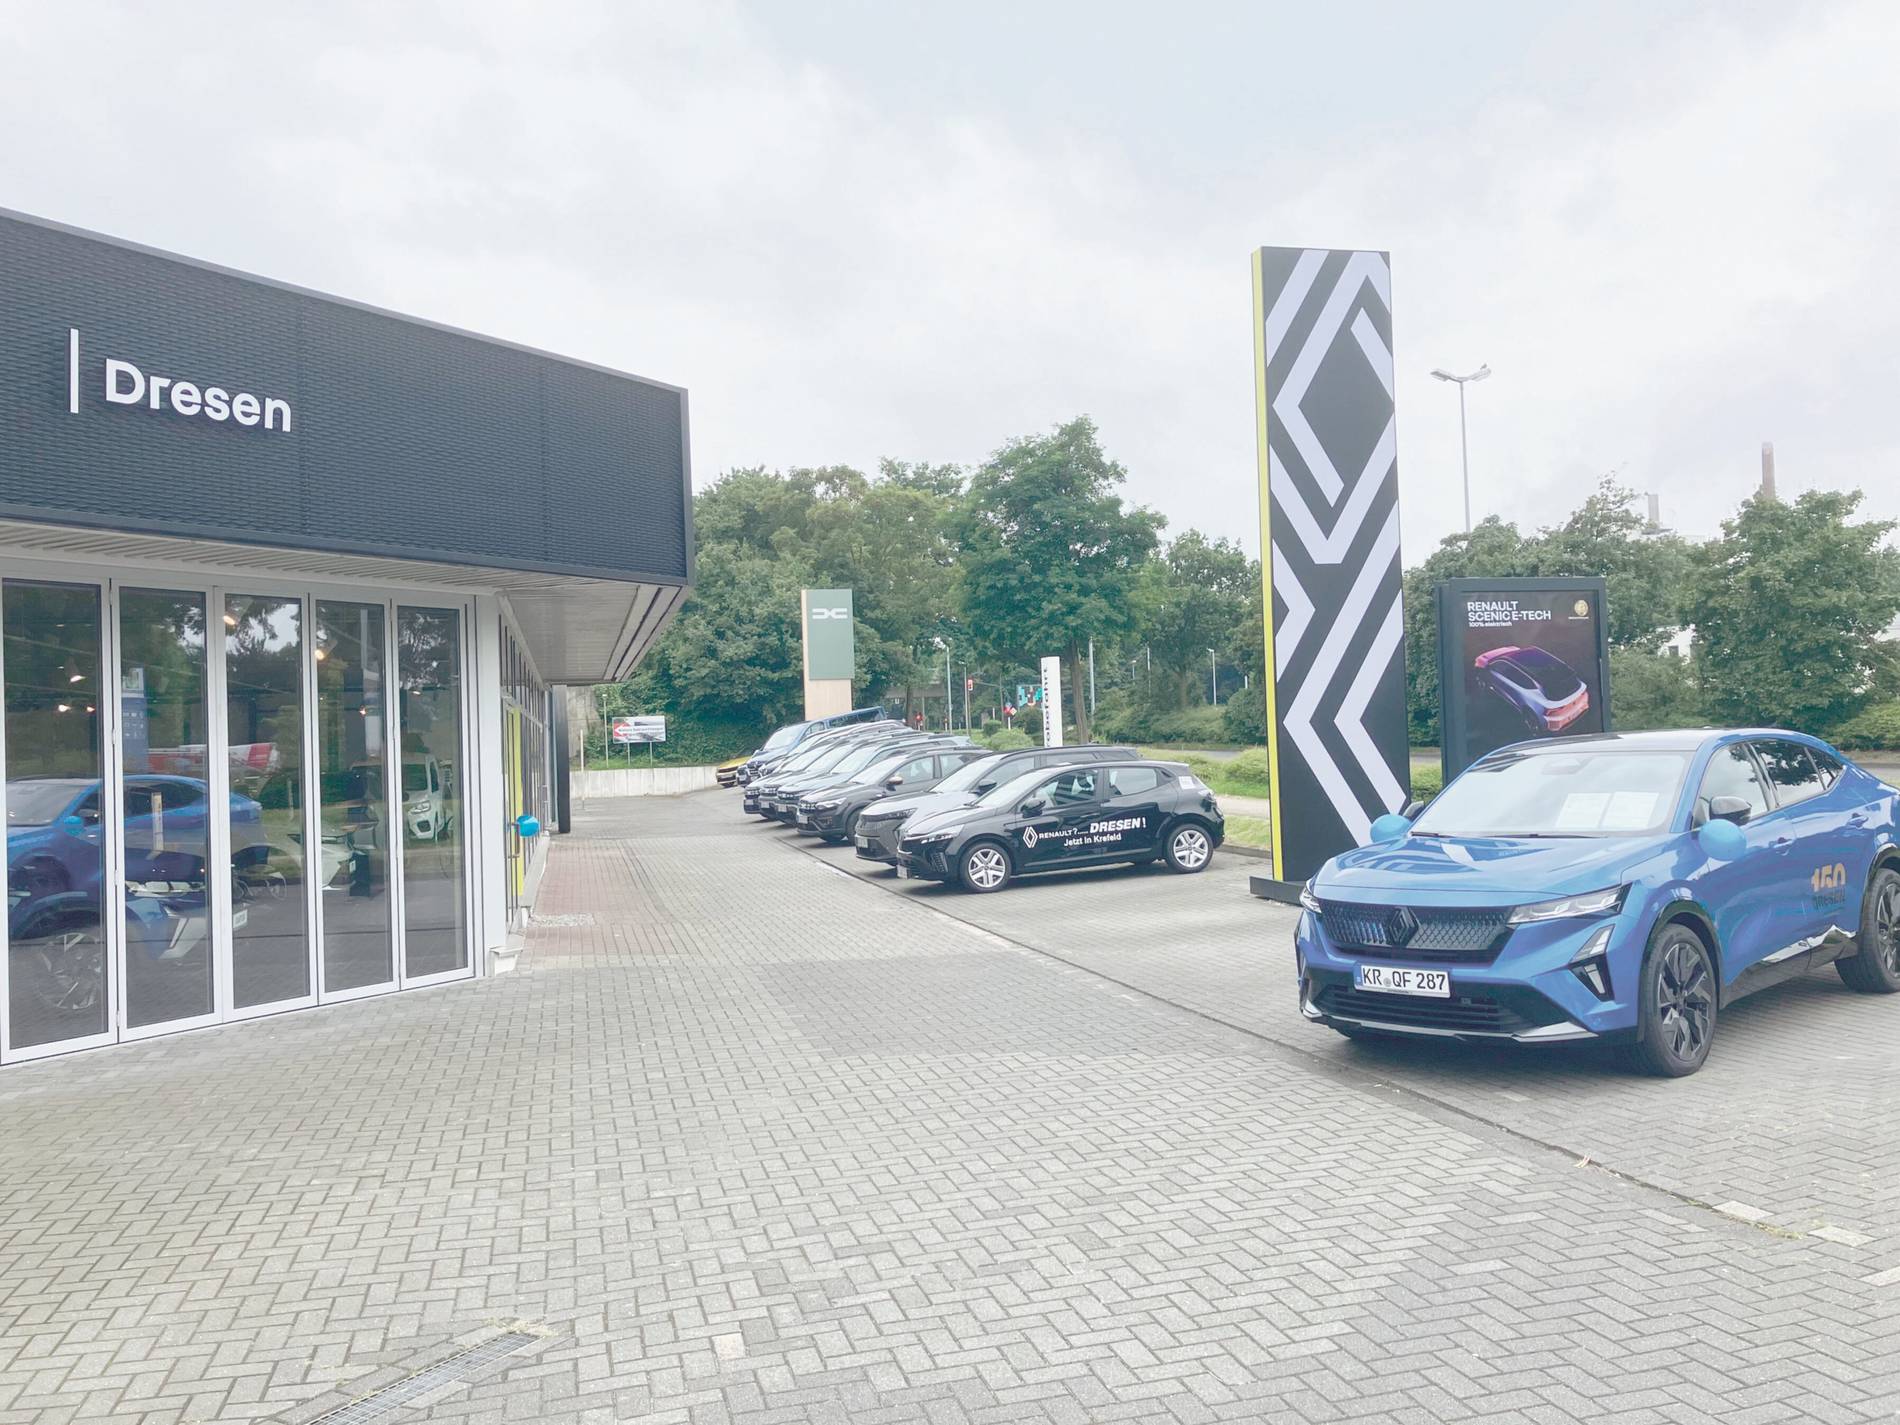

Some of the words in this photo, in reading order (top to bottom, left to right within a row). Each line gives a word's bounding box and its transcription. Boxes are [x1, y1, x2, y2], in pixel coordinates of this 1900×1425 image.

[106, 358, 291, 432] Dresen
[1467, 601, 1519, 612] RENAULT
[1468, 611, 1511, 622] SCENIC
[1512, 610, 1551, 621] E-TECH
[1063, 838, 1083, 847] Jetzt
[1093, 833, 1122, 843] Krefeld
[1362, 967, 1382, 986] KR
[1392, 970, 1412, 988] QF
[1416, 972, 1446, 991] 287
